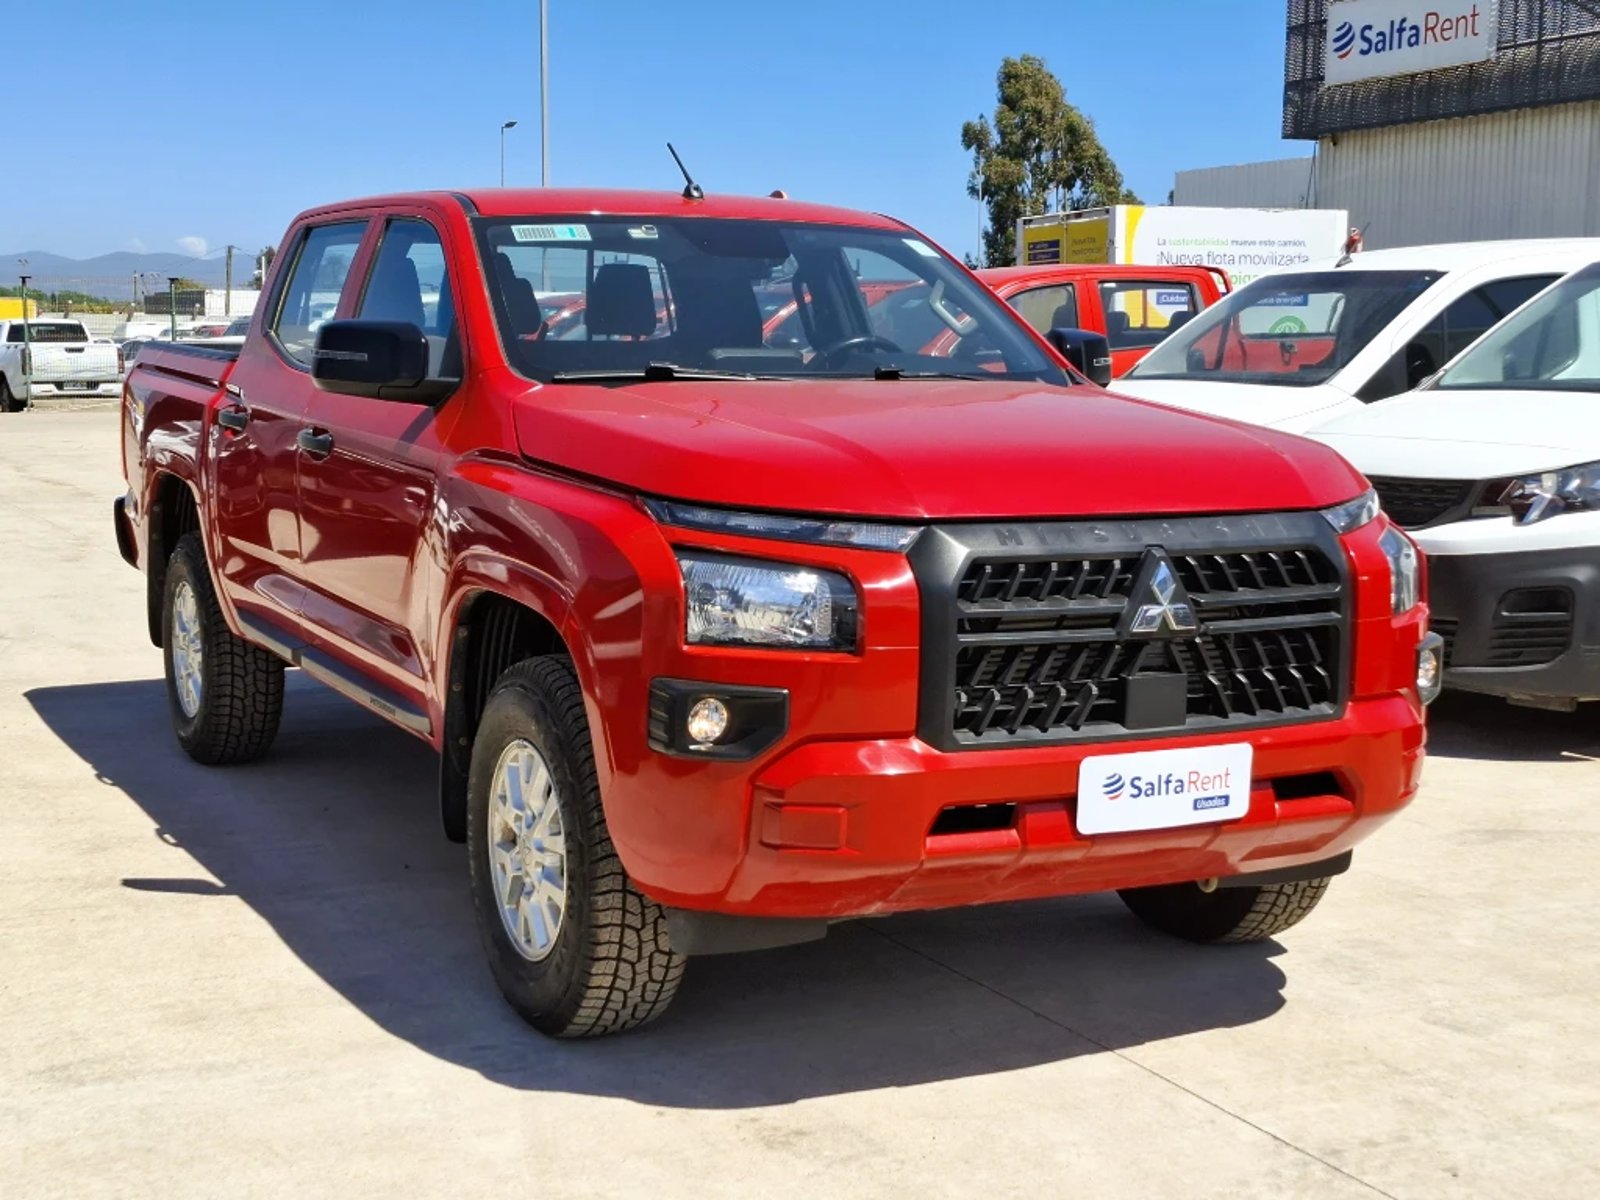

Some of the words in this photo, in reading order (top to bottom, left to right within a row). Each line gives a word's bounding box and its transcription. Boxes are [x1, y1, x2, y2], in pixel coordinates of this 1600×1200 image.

[1359, 4, 1479, 56] SalfaRent
[1157, 238, 1167, 246] La
[1206, 251, 1235, 265] flota
[1129, 767, 1232, 799] SalfaRent
